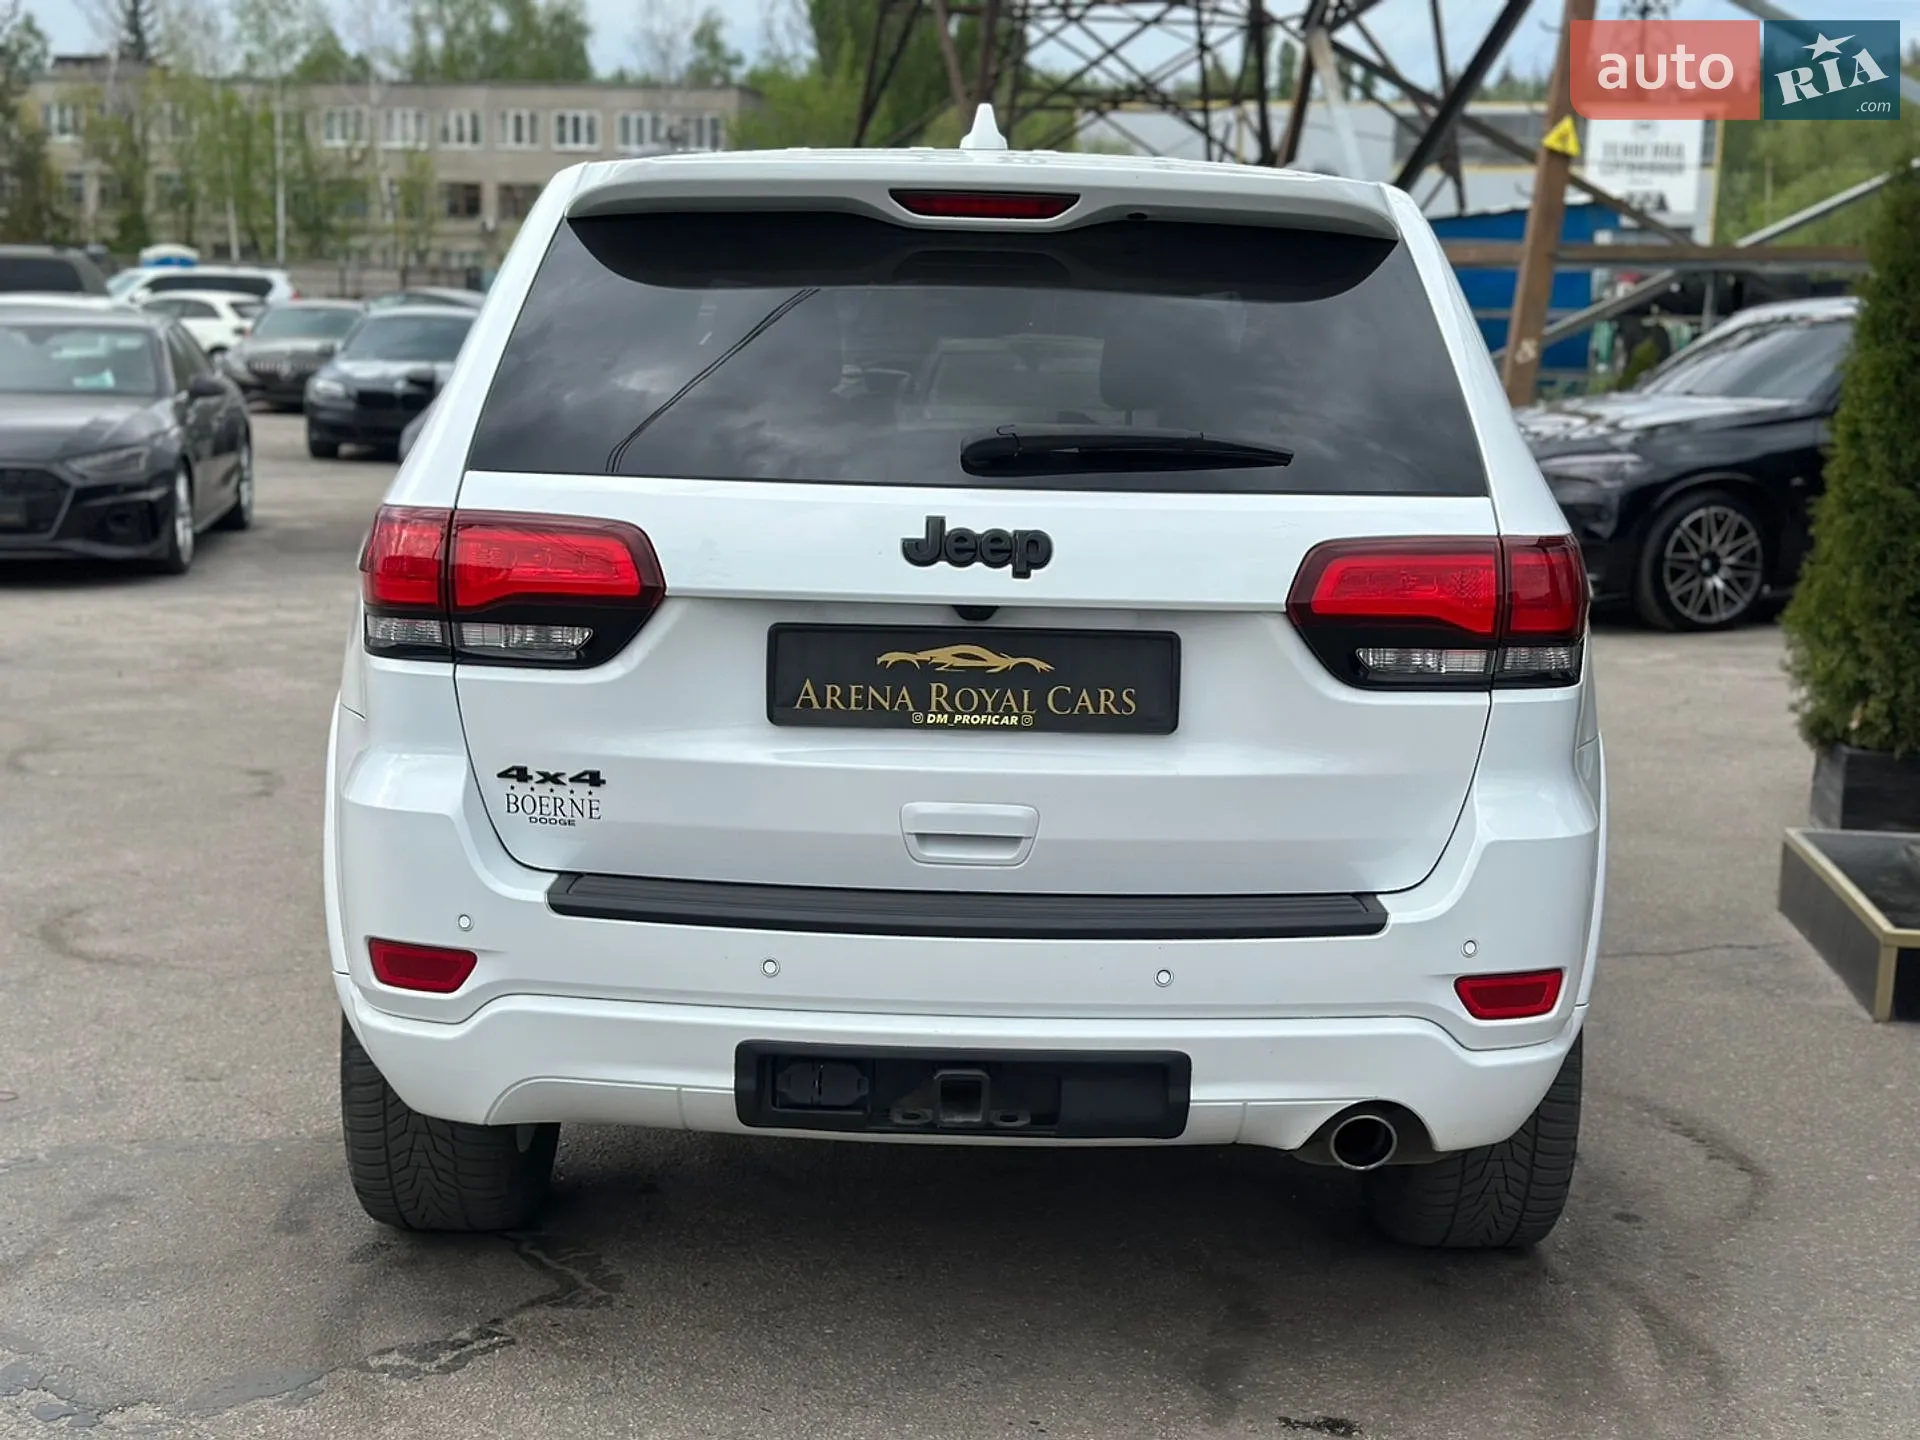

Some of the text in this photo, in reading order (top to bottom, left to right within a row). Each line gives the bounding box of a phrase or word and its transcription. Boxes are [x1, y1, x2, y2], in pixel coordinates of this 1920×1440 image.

[902, 515, 1053, 578] Jeep
[794, 678, 1136, 715] ARENA ROYAL CARS
[926, 713, 1019, 726] DM_PROFICAR
[497, 765, 606, 787] 4x4
[506, 793, 602, 819] BOERNE
[529, 816, 576, 826] DODGE
